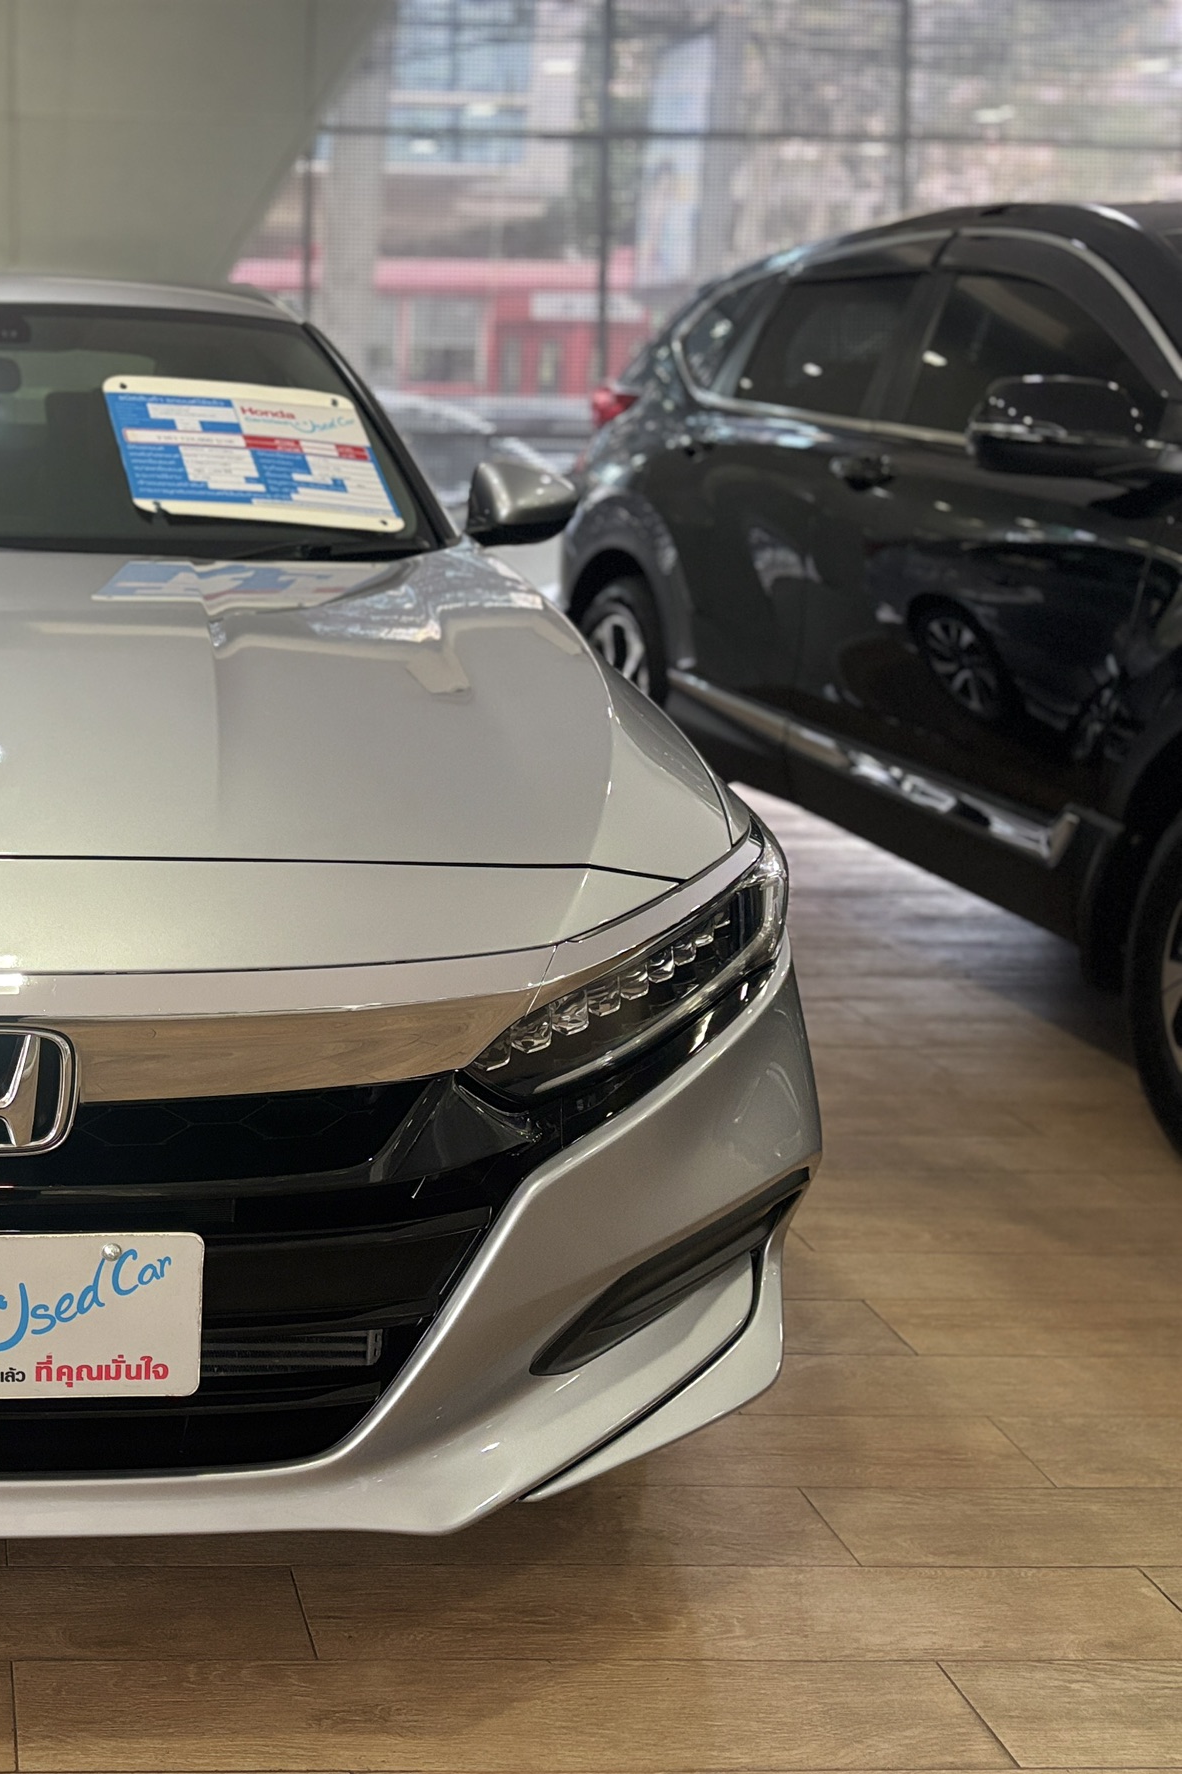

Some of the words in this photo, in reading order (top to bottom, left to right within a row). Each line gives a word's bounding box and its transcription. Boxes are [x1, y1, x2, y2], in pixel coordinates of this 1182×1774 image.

[240, 406, 296, 420] Honda
[111, 1248, 172, 1297] Car
[34, 1354, 170, 1389] ที่คุณมั่นใจ
